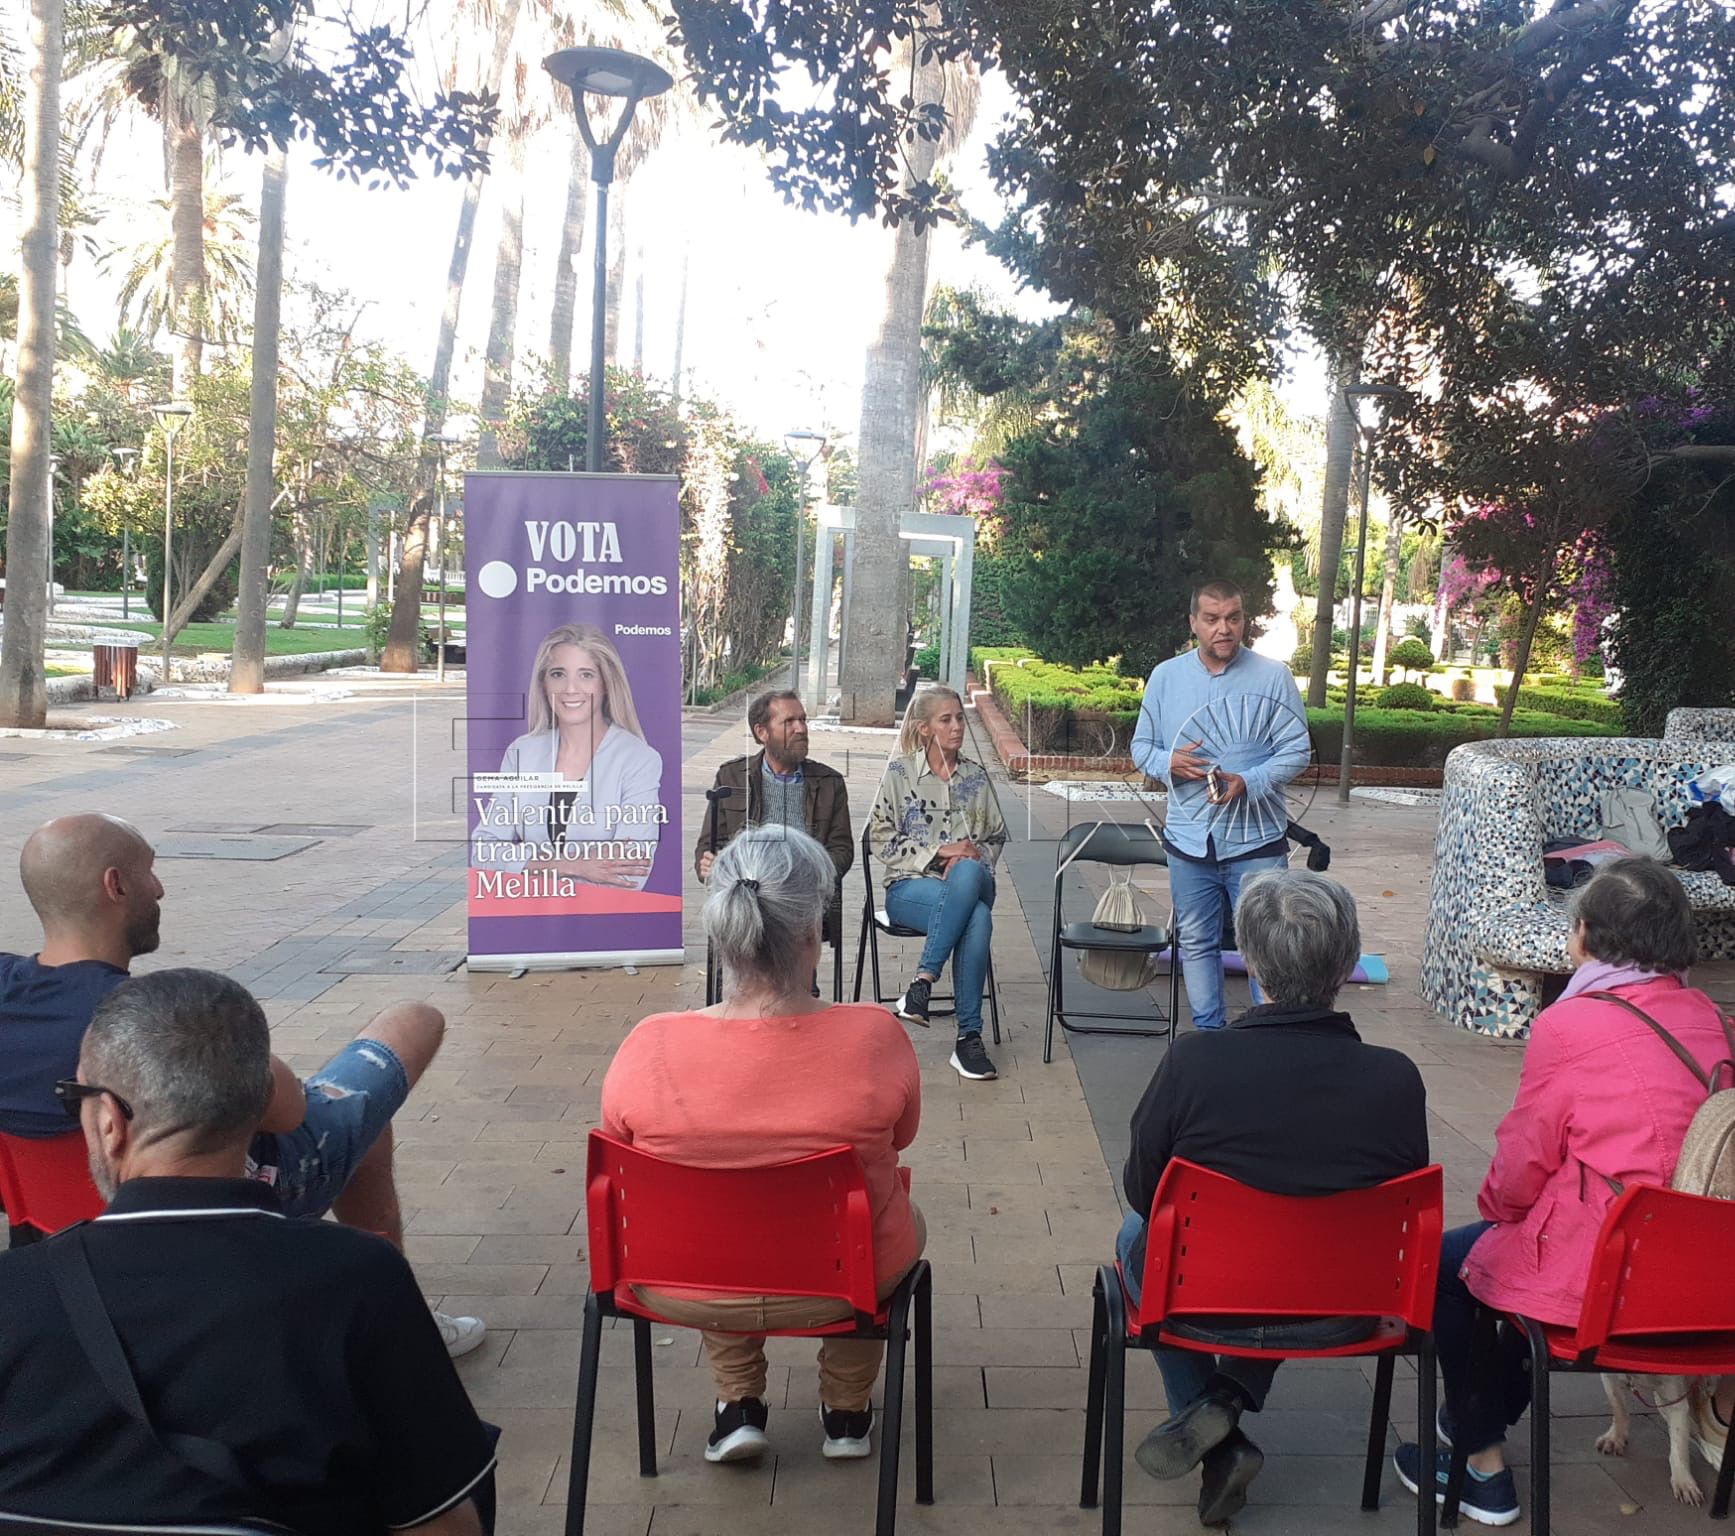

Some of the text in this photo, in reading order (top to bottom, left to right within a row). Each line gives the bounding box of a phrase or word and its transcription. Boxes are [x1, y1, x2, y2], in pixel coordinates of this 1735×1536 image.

[525, 521, 623, 563] VOTA
[527, 567, 668, 595] Podemos
[615, 624, 672, 636] Podemos
[474, 798, 669, 830] Valentía para
[475, 832, 657, 863] transformar
[475, 870, 576, 899] Melilla
